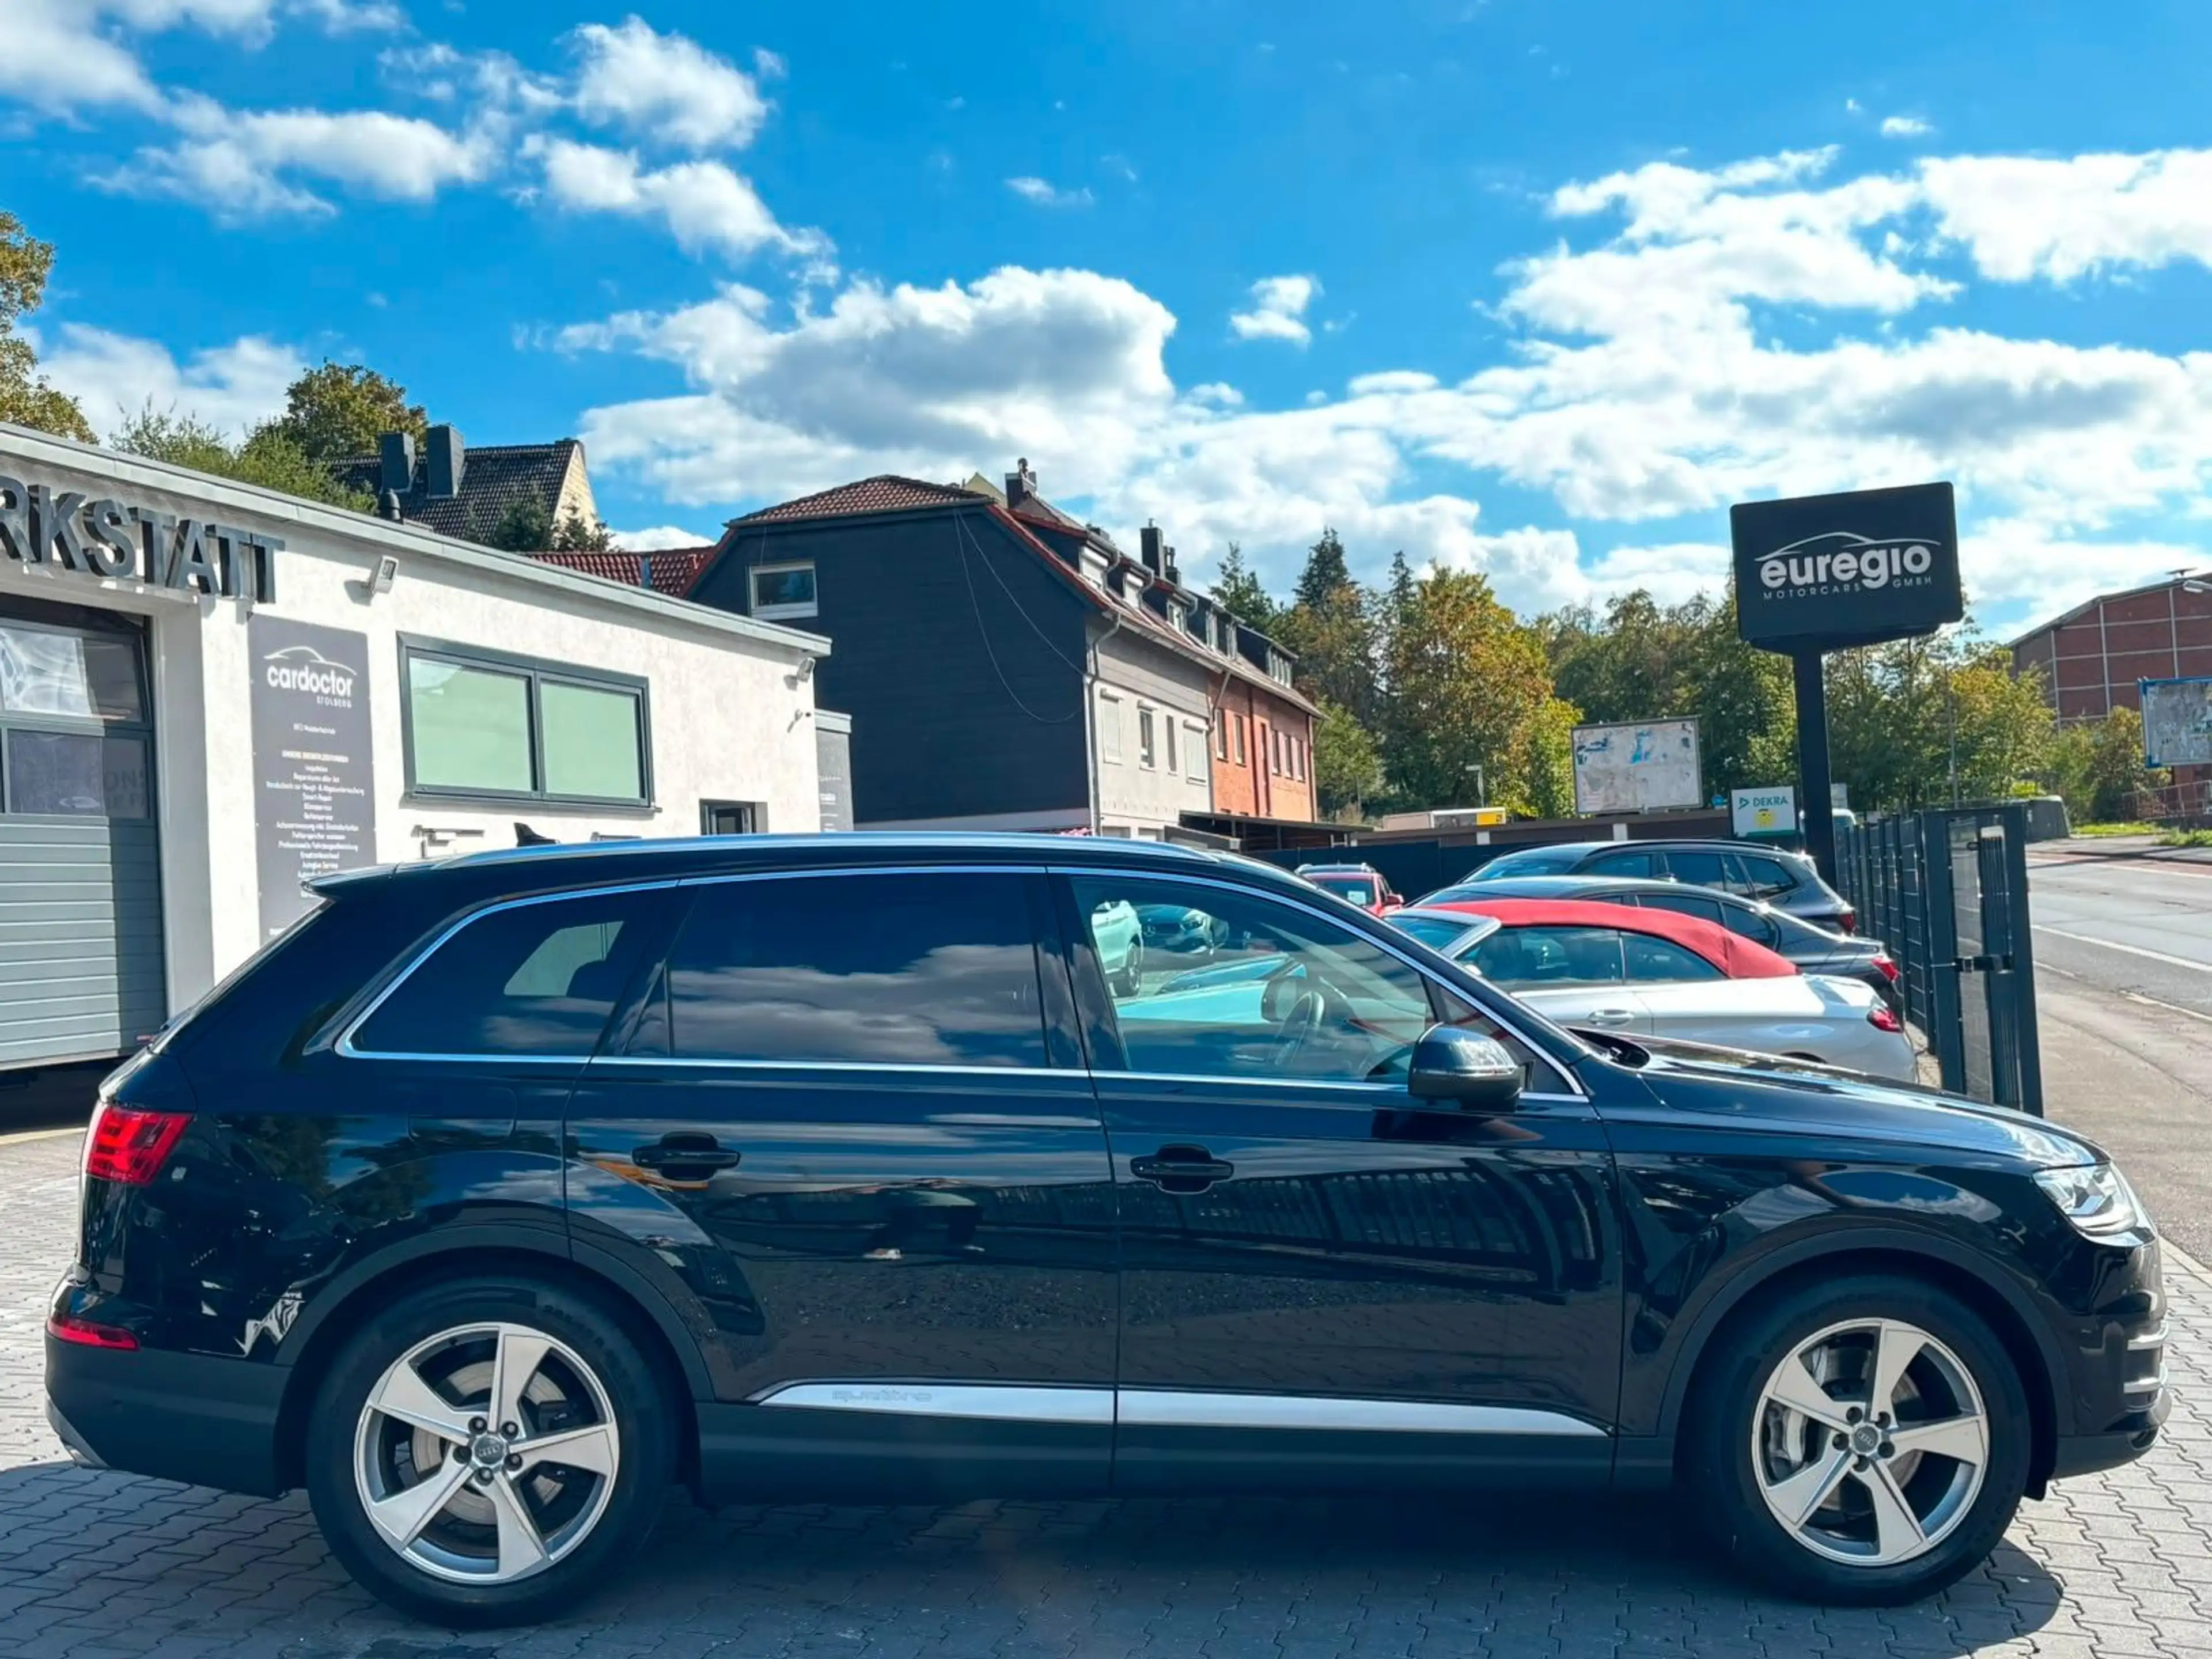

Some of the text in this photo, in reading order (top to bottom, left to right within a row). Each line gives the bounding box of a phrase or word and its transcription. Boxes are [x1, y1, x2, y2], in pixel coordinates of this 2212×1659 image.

[1760, 546, 1931, 589] euregio
[1763, 576, 1933, 600] MOTORCARS GMBH
[267, 664, 353, 698] cardoctor
[1753, 796, 1789, 807] DEKRA
